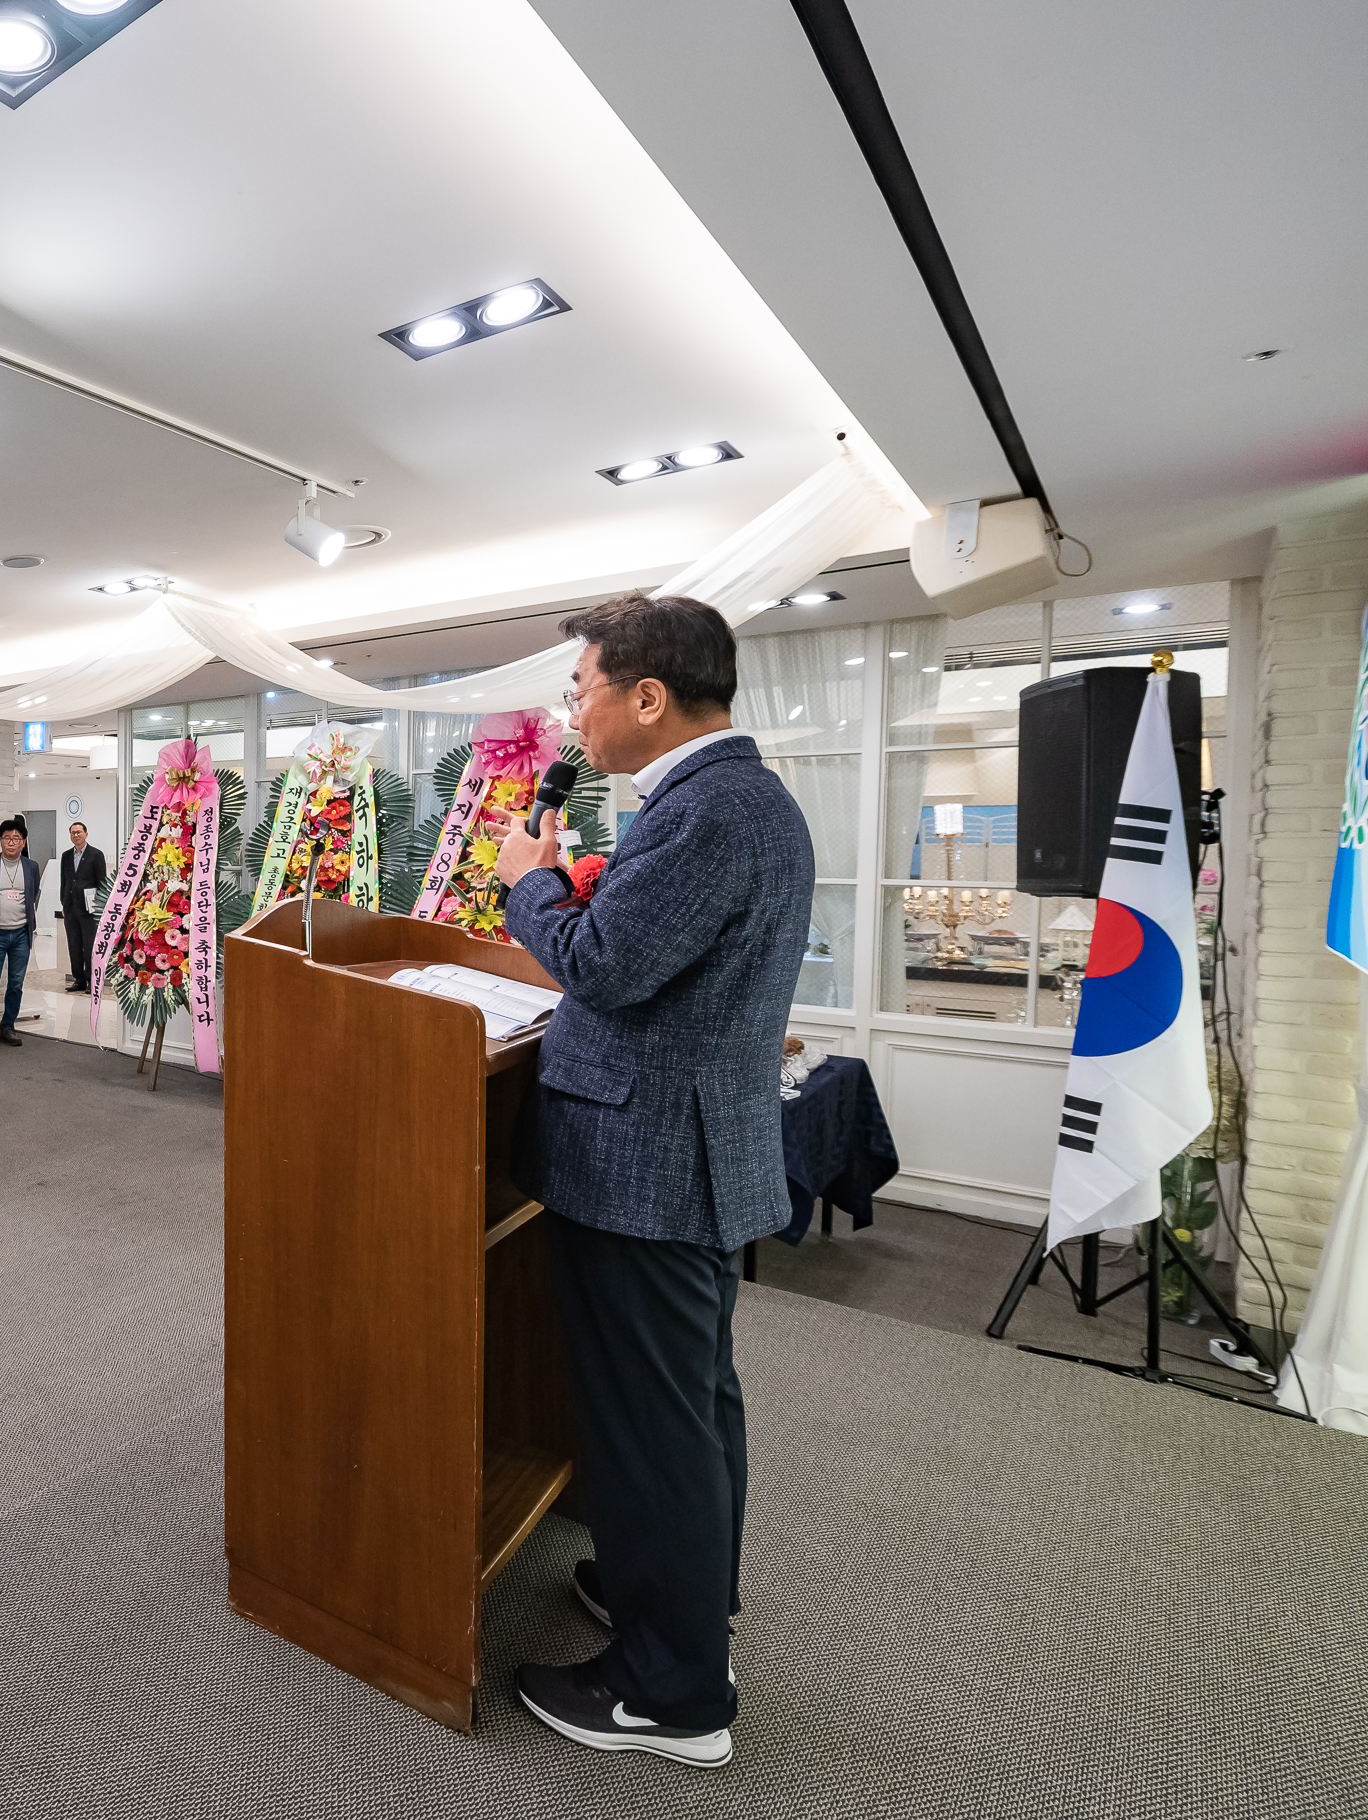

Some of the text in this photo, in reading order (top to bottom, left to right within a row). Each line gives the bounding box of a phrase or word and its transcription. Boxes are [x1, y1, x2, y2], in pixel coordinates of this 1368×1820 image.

[270, 786, 303, 860] 재경금호고
[95, 902, 122, 959] 동창회
[194, 806, 215, 1027] 정종수님 등단을 축하합니다
